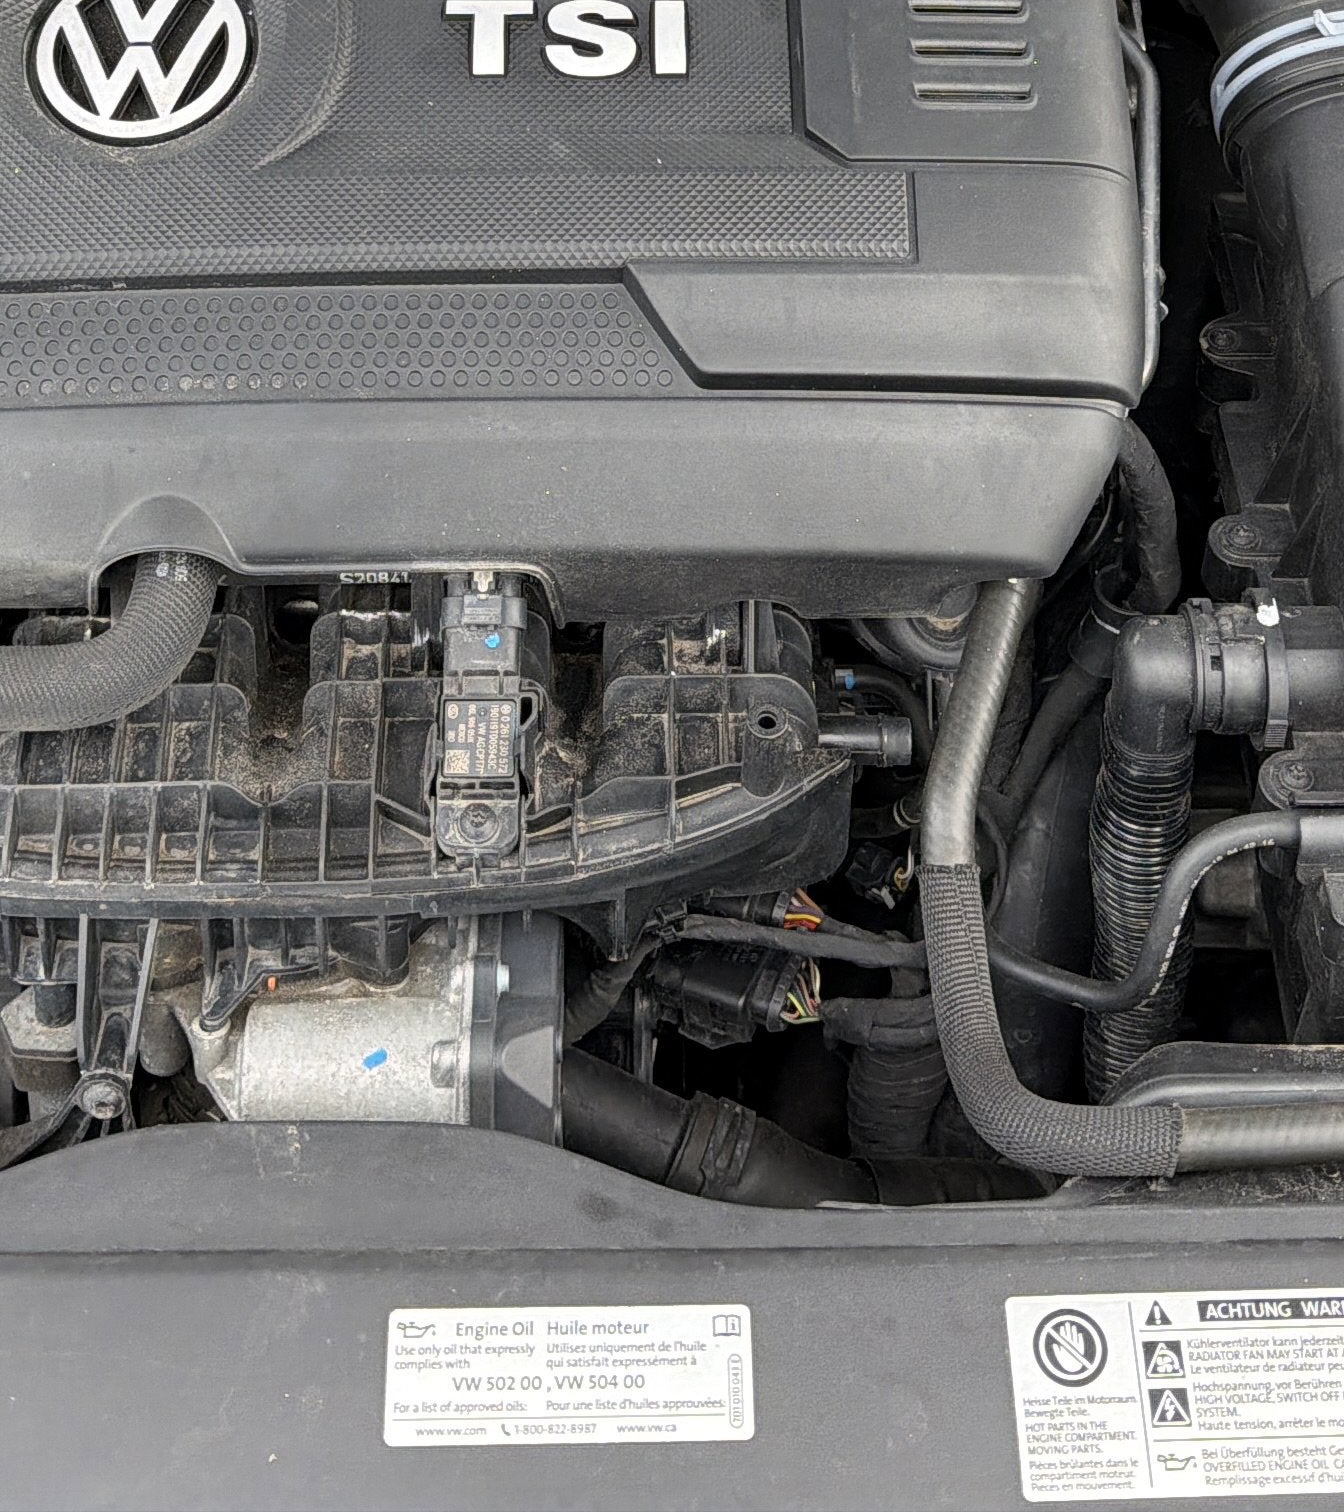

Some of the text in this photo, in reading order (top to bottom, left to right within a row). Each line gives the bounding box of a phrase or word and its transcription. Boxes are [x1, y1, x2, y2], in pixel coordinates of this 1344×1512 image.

[444, 0, 688, 77] TSI
[499, 723, 509, 738] 261
[1206, 1300, 1292, 1320] ACHTUNG
[456, 1321, 534, 1341] Engine Oil
[547, 1320, 650, 1336] Huile moteur
[546, 1341, 707, 1356] Utilisez uniquement de l'huile
[1187, 1335, 1344, 1349] Kühlerventilator kann jederzeit
[395, 1344, 535, 1359] Use only oil that expressly
[1189, 1350, 1241, 1361] RADIATOR
[1243, 1350, 1265, 1360] FAN
[1266, 1349, 1290, 1359] MAY
[1292, 1348, 1323, 1358] START
[1327, 1348, 1339, 1358] AT
[394, 1358, 471, 1373] complies with
[546, 1355, 697, 1370] qui satisfait expressément à
[1191, 1365, 1201, 1374] Le
[1204, 1363, 1260, 1374] ventilateur
[1263, 1362, 1276, 1372] de
[1278, 1362, 1325, 1372] radiateur
[452, 1374, 645, 1392] VW 502 00 VW 504 00
[1275, 1382, 1292, 1390] vor
[1294, 1378, 1341, 1390] Berühren
[546, 1398, 661, 1411] Pour une liste d'huiles
[1052, 1395, 1086, 1406] Teile im
[1195, 1394, 1223, 1404] HIGH
[1277, 1392, 1318, 1403] SWITCH
[1320, 1391, 1340, 1402] OFF
[393, 1401, 504, 1416] For a list of approved
[1024, 1408, 1064, 1420] Bewegte
[1197, 1407, 1241, 1418] SYSTEM.
[416, 1423, 677, 1436] www.vw.com www.vw.ca
[1025, 1421, 1108, 1432] HOT PARTS IN THE
[1199, 1420, 1231, 1431] Haute
[1234, 1419, 1276, 1431] tension,
[1315, 1417, 1325, 1427] le
[1027, 1431, 1137, 1443] ENGINE COMPARTMENT.
[1028, 1444, 1103, 1455] MOVING PARTS.
[1202, 1448, 1218, 1459] Bei
[1220, 1446, 1285, 1461] Überfüllung
[1287, 1446, 1326, 1457] besteht
[1130, 1457, 1138, 1467] le
[1204, 1461, 1265, 1472] OVERFILLED
[1268, 1459, 1308, 1471] ENGINE
[1311, 1459, 1329, 1469] OIL
[1206, 1474, 1271, 1488] Remplissage
[1273, 1471, 1315, 1484] excessif
